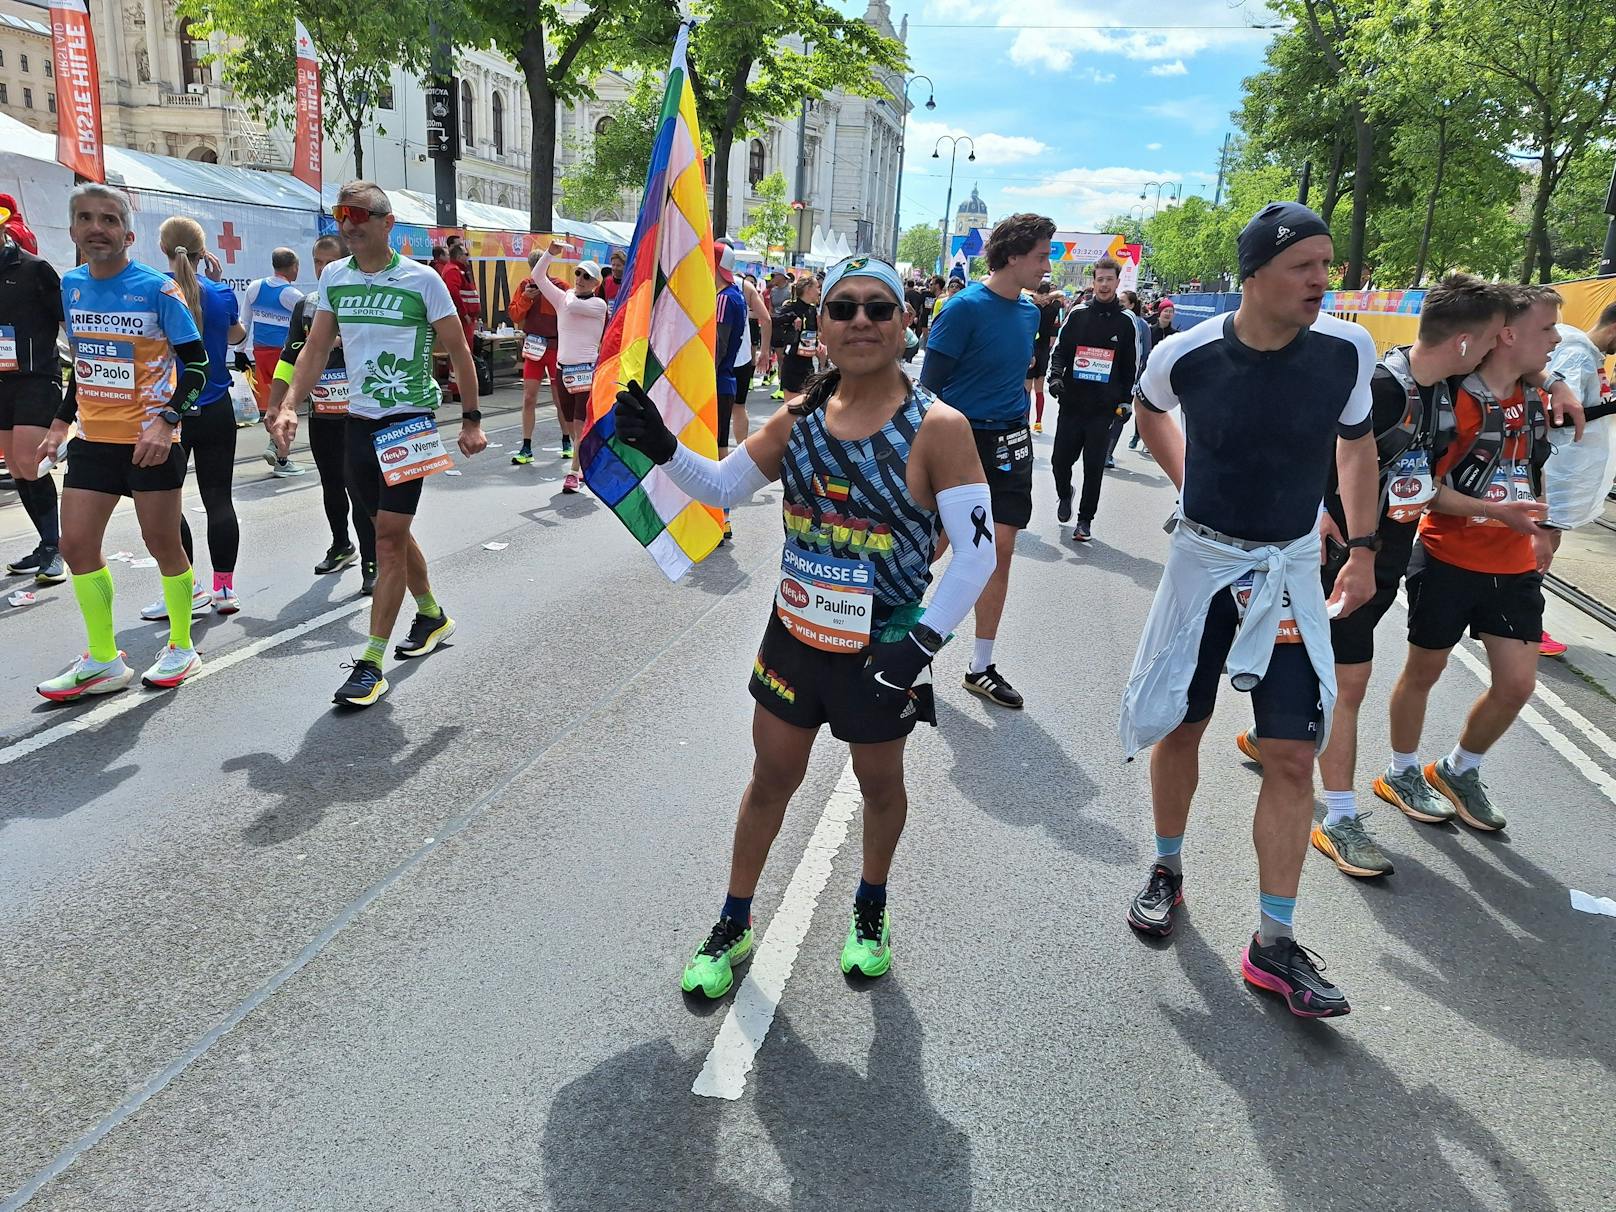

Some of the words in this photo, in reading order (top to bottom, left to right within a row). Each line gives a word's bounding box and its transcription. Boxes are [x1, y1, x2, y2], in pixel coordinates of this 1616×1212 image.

[339, 293, 403, 310] milli
[352, 308, 385, 317] SPORTS
[115, 327, 144, 336] TEAM
[78, 342, 106, 356] ERSTE
[94, 363, 130, 380] Paolo
[375, 422, 426, 445] SPARKASSE
[382, 449, 407, 462] Hervis
[1014, 445, 1029, 461] 559
[402, 466, 423, 477] WIEN
[784, 549, 851, 582] SPARKASSE
[782, 580, 807, 604] Hervis
[815, 594, 866, 617] Paulino
[795, 623, 817, 640] WIEN
[818, 633, 865, 650] ENERGIE
